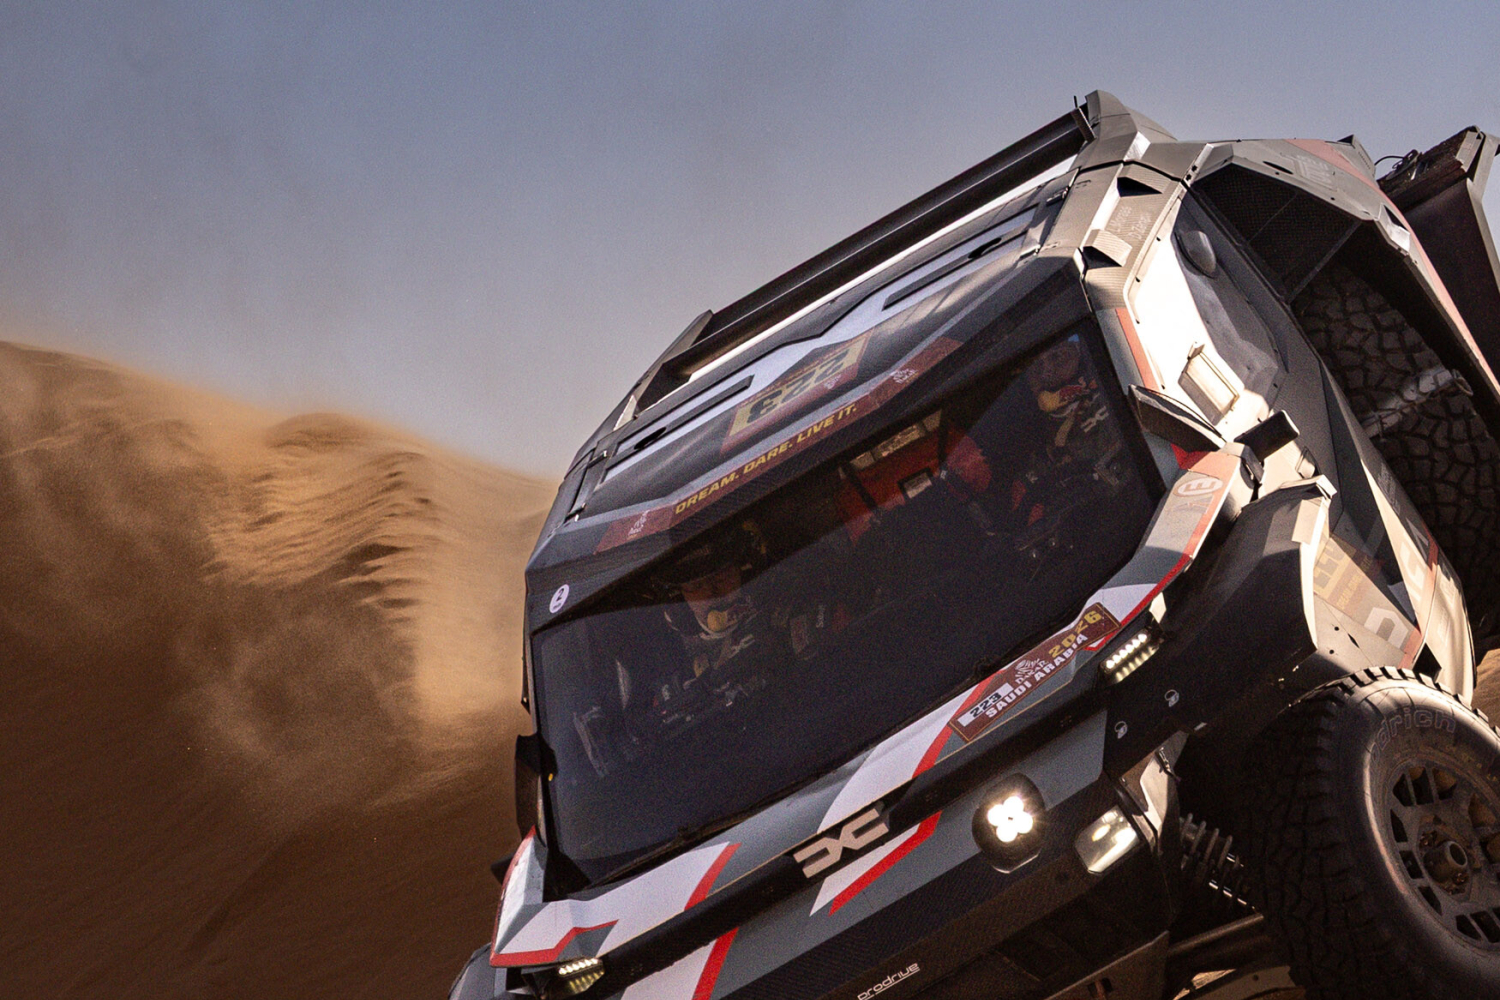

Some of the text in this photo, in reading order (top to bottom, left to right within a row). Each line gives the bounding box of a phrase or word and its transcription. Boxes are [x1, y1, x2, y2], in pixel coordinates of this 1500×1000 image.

[675, 403, 858, 515] DREAM. DARE. LIVE IT.
[1048, 610, 1103, 659] 2026
[969, 691, 1002, 718] 223
[985, 633, 1089, 718] SAUDI ARABIA
